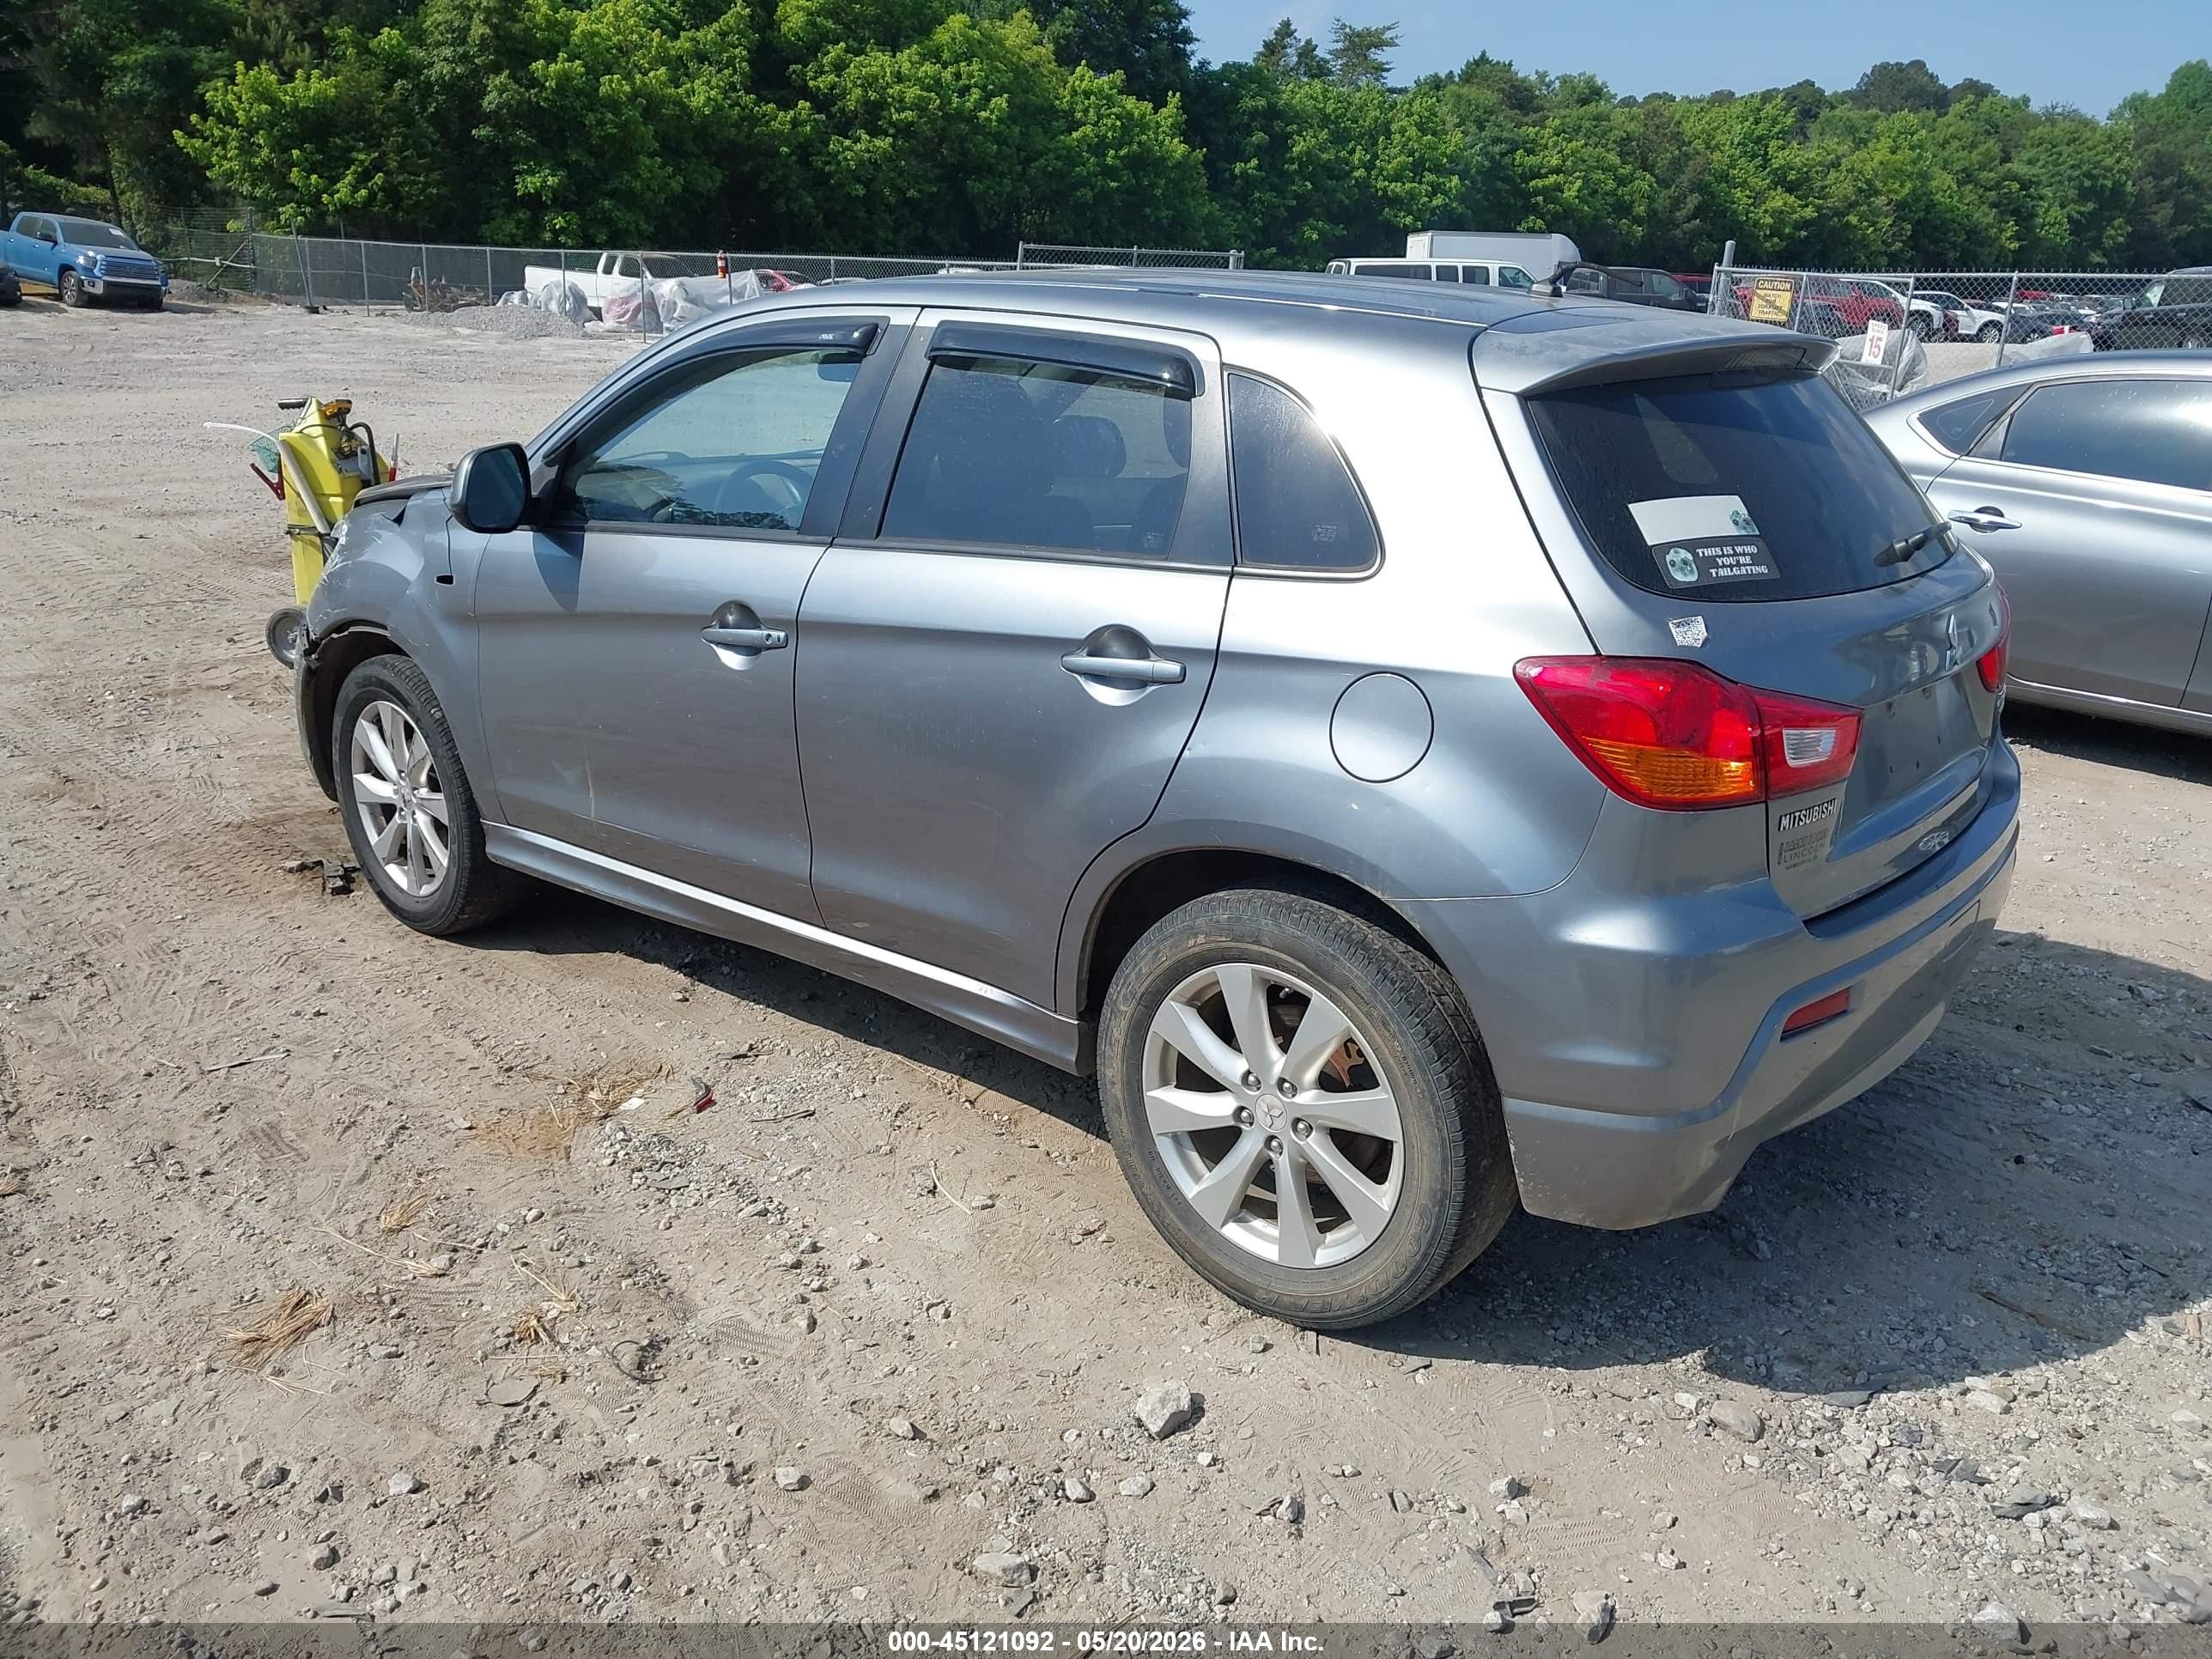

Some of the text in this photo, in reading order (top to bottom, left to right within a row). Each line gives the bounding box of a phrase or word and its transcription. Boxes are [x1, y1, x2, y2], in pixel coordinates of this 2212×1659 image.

[1758, 280, 1791, 290] CAUTION
[1868, 335, 1883, 359] 15
[1696, 545, 1758, 556] THIS IS WHO
[1716, 556, 1752, 566] YOU'RE
[1710, 565, 1768, 577] TAILGATING
[1779, 799, 1838, 831] MITSUBISHI
